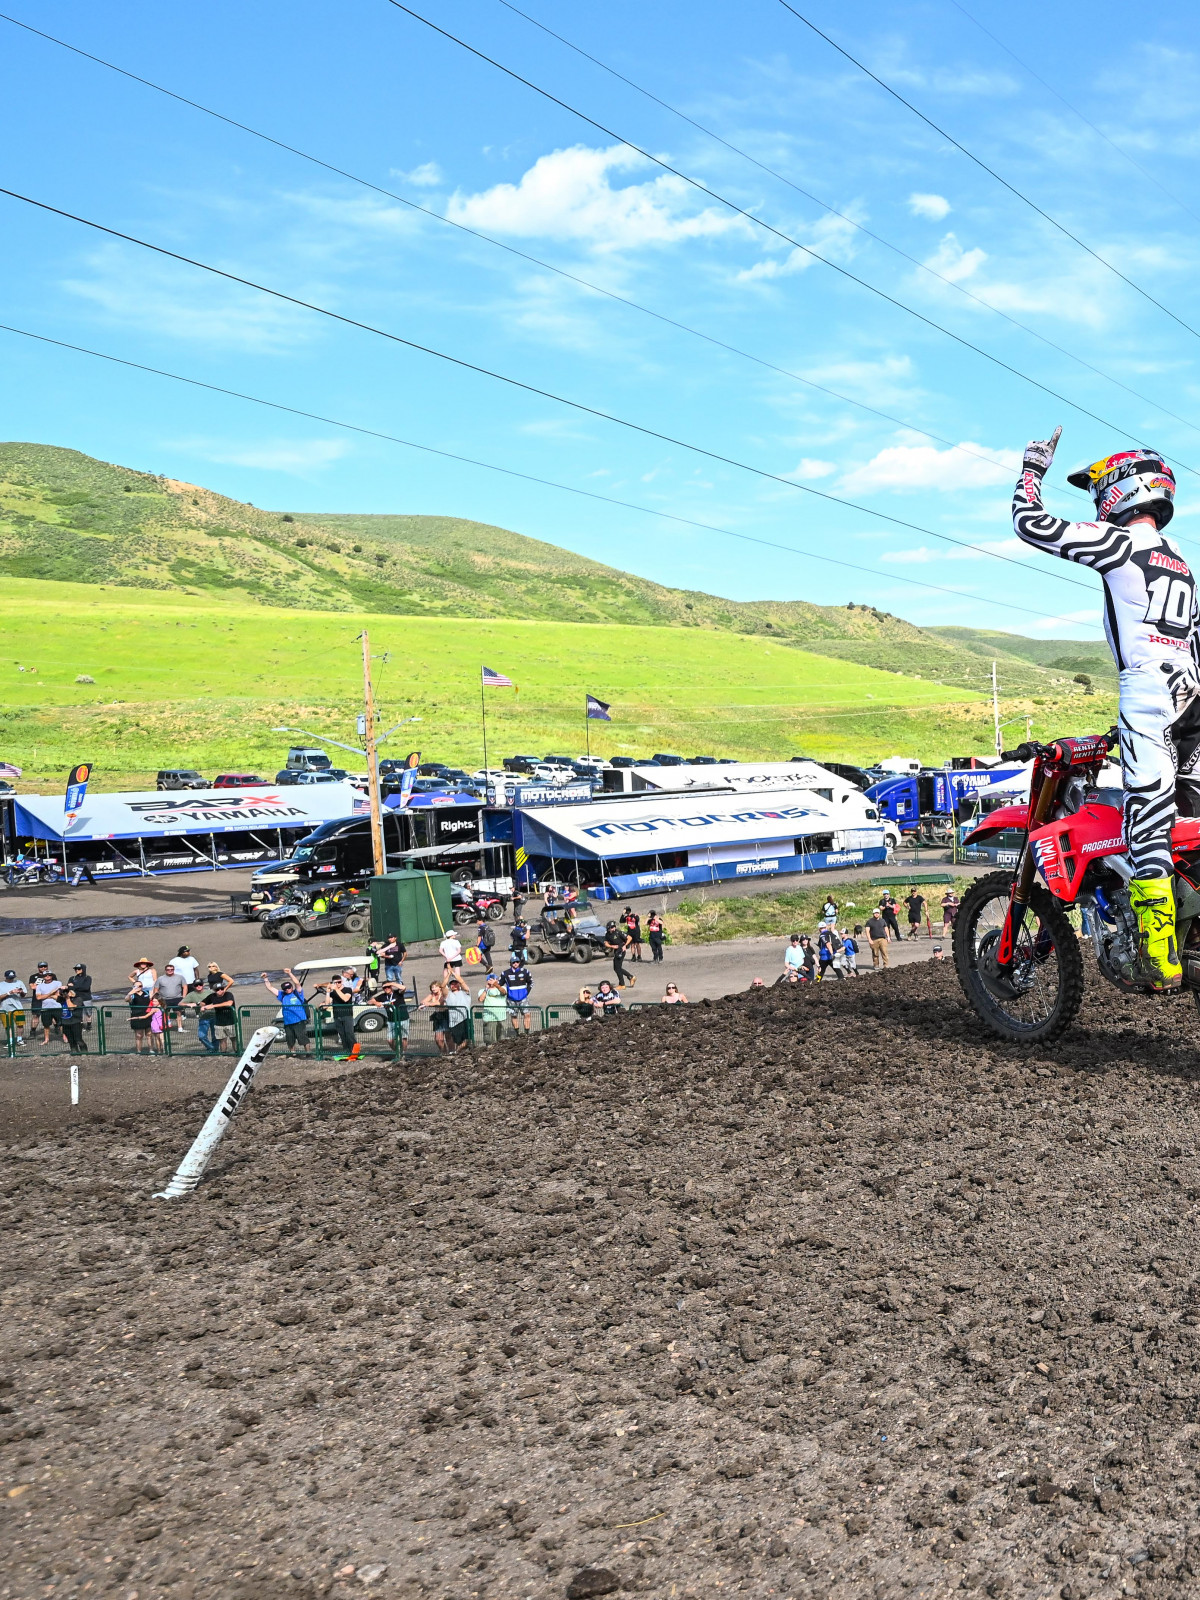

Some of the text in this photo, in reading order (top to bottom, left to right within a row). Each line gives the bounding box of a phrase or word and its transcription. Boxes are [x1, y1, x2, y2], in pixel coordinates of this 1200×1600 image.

[1101, 486, 1123, 513] Bull
[1148, 551, 1190, 576] HYMAS
[1144, 575, 1192, 628] 10
[1073, 742, 1106, 752] RENTHAL
[521, 788, 591, 800] MOTOCROSS
[180, 807, 309, 821] YAMAHA
[440, 820, 476, 832] Rights.
[582, 807, 829, 838] MOTOCROSS
[1035, 836, 1057, 867] CRF
[221, 1063, 253, 1118] UFO
